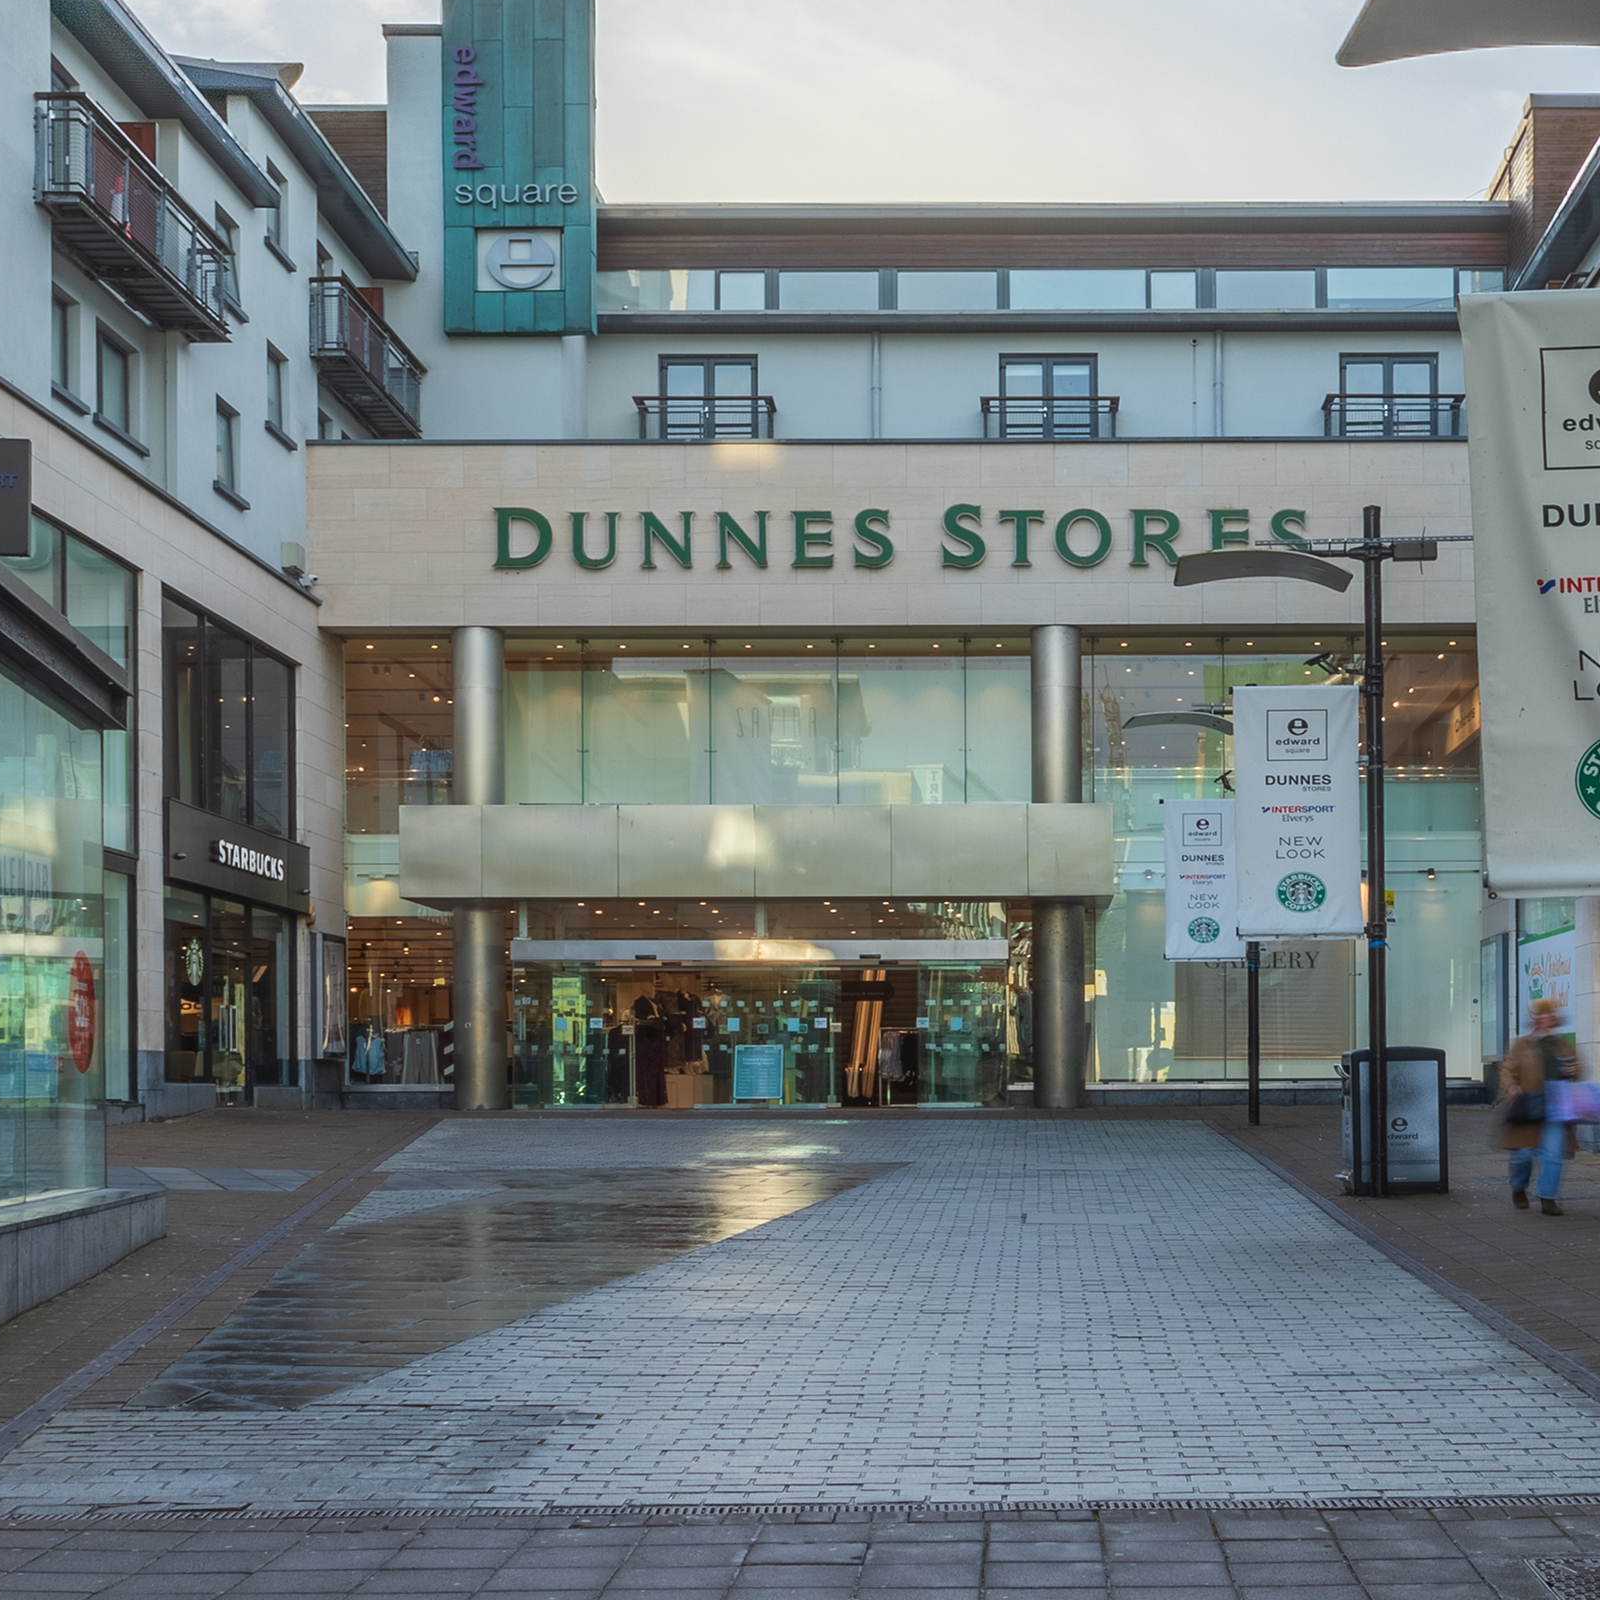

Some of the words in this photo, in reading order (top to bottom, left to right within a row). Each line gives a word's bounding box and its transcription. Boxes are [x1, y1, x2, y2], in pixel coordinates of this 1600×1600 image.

[454, 45, 485, 170] edward
[455, 183, 578, 209] square
[492, 506, 896, 570] DUNNES
[940, 502, 1309, 570] STORES
[1275, 737, 1321, 746] edward
[1265, 774, 1332, 786] DUNNES
[1271, 805, 1335, 814] INTERSPORT
[1282, 814, 1314, 823] Elverys
[1278, 836, 1323, 846] NEW
[1181, 854, 1225, 862] DUNNES
[1276, 849, 1326, 859] LOOK
[218, 839, 284, 881] STARBUCKS
[1279, 874, 1324, 892] STARBUCKS
[1284, 900, 1319, 911] COFFEE
